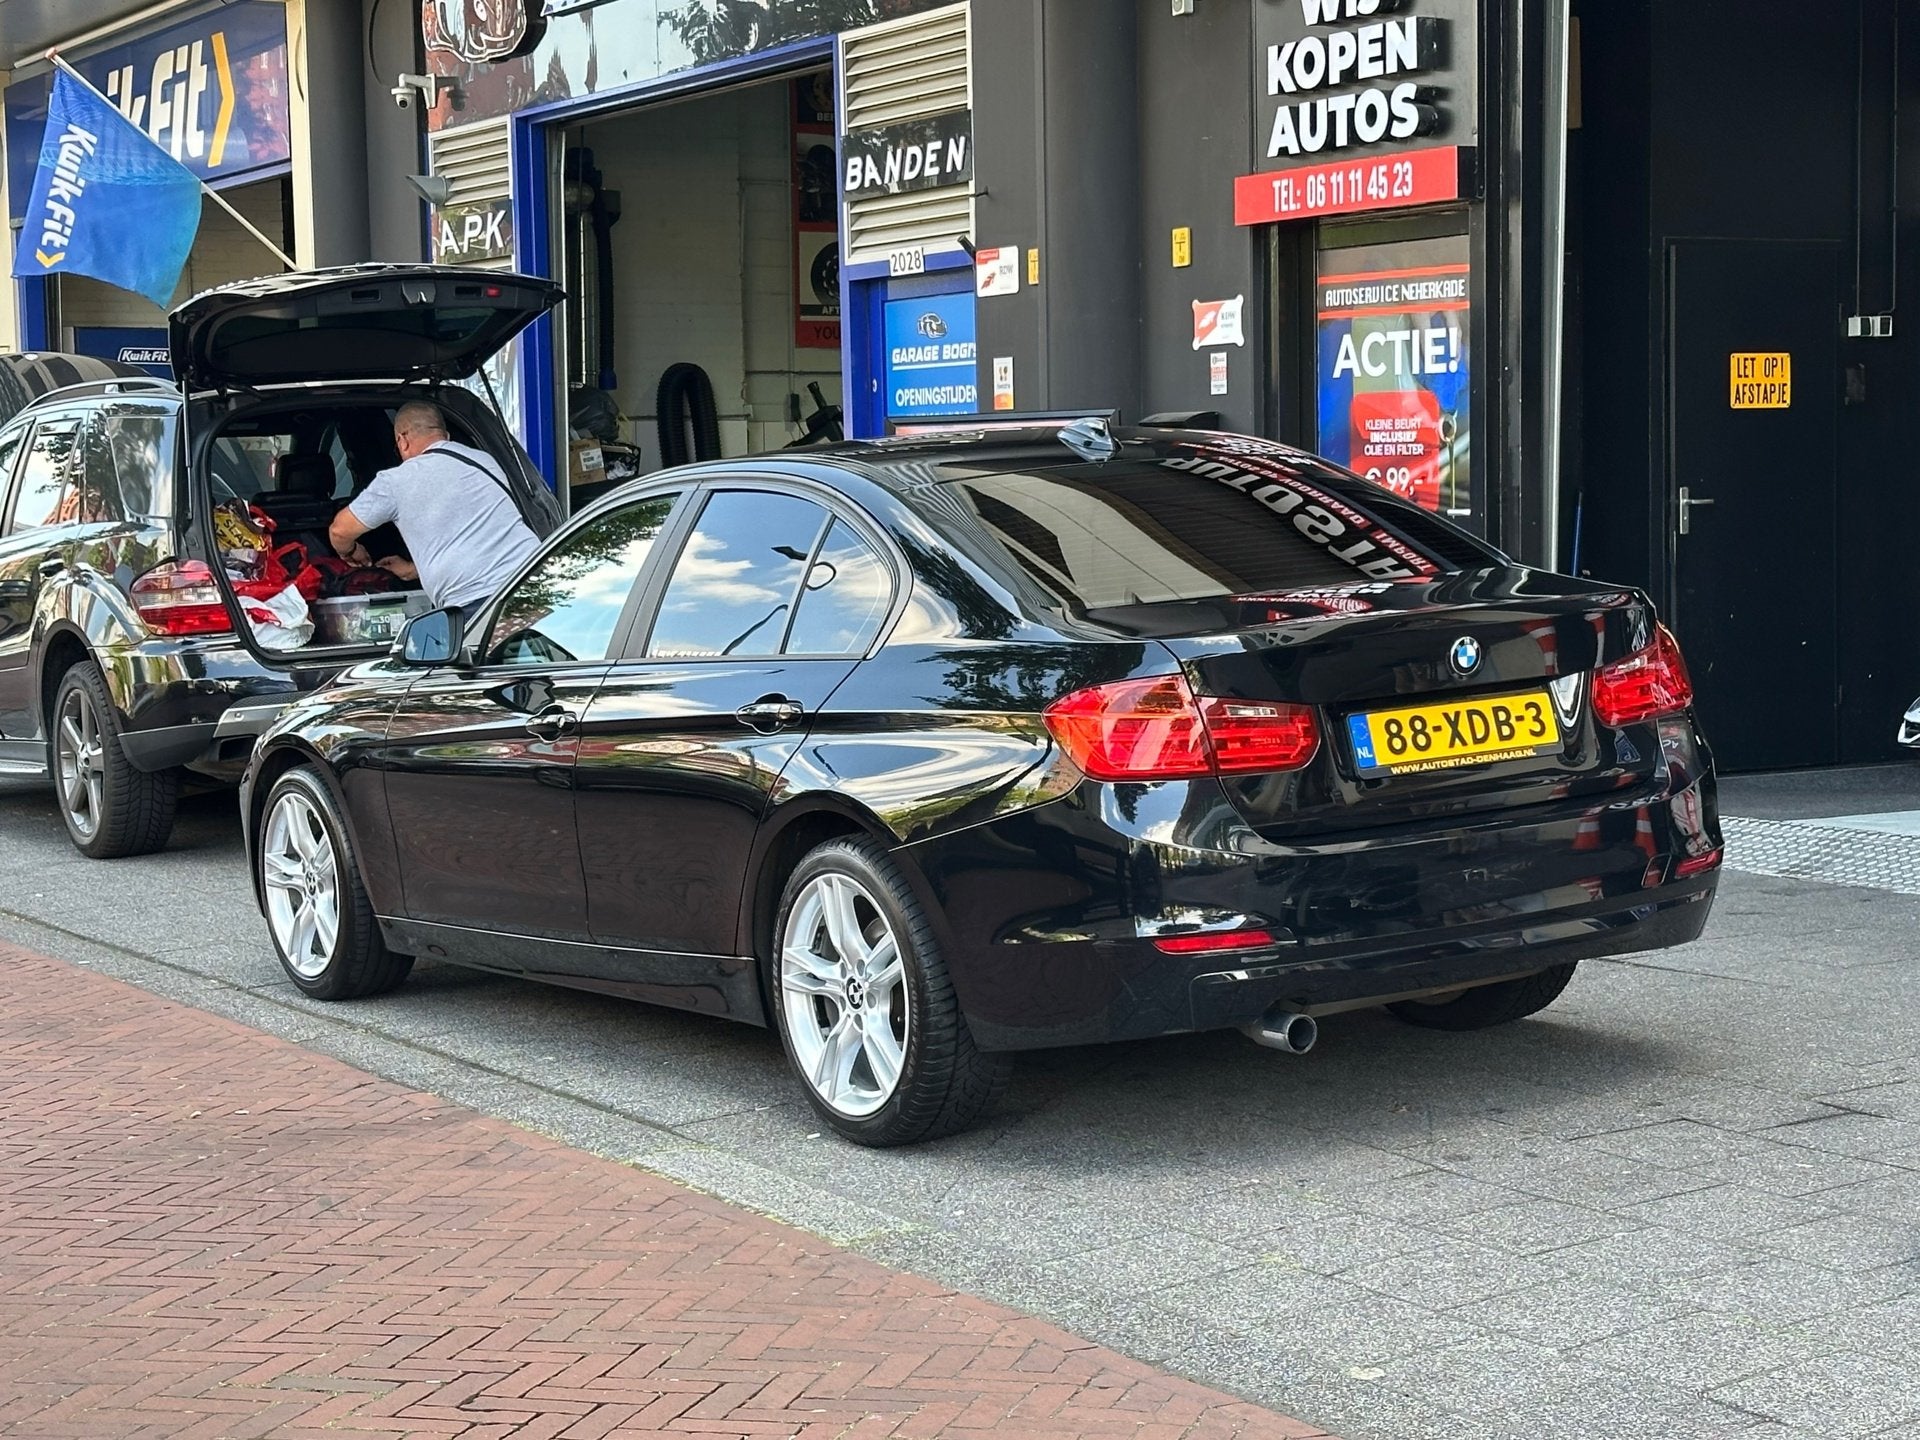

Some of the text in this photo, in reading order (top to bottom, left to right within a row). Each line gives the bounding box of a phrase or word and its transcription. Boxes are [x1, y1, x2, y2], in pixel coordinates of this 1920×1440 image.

[1267, 16, 1418, 96] KOPEN
[1266, 82, 1420, 158] AUTOS
[845, 135, 966, 191] BANDEN
[1272, 161, 1413, 213] TEL: 06 11 11 45 23
[440, 209, 507, 257] APK
[891, 250, 922, 273] 2028
[1325, 284, 1400, 307] AUTOSERVICE
[892, 344, 940, 364] GARAGE
[1332, 327, 1458, 379] ACTIE!
[1737, 357, 1784, 378] LET OP!
[1734, 383, 1788, 404] AFSTAPJE
[1365, 417, 1422, 431] KLEINE BEURT
[1370, 431, 1417, 443] INCLUSIEF
[1384, 444, 1395, 456] EN
[1397, 444, 1424, 456] FILTER
[1384, 701, 1546, 756] 88-XDB-3
[1357, 747, 1373, 760] NL
